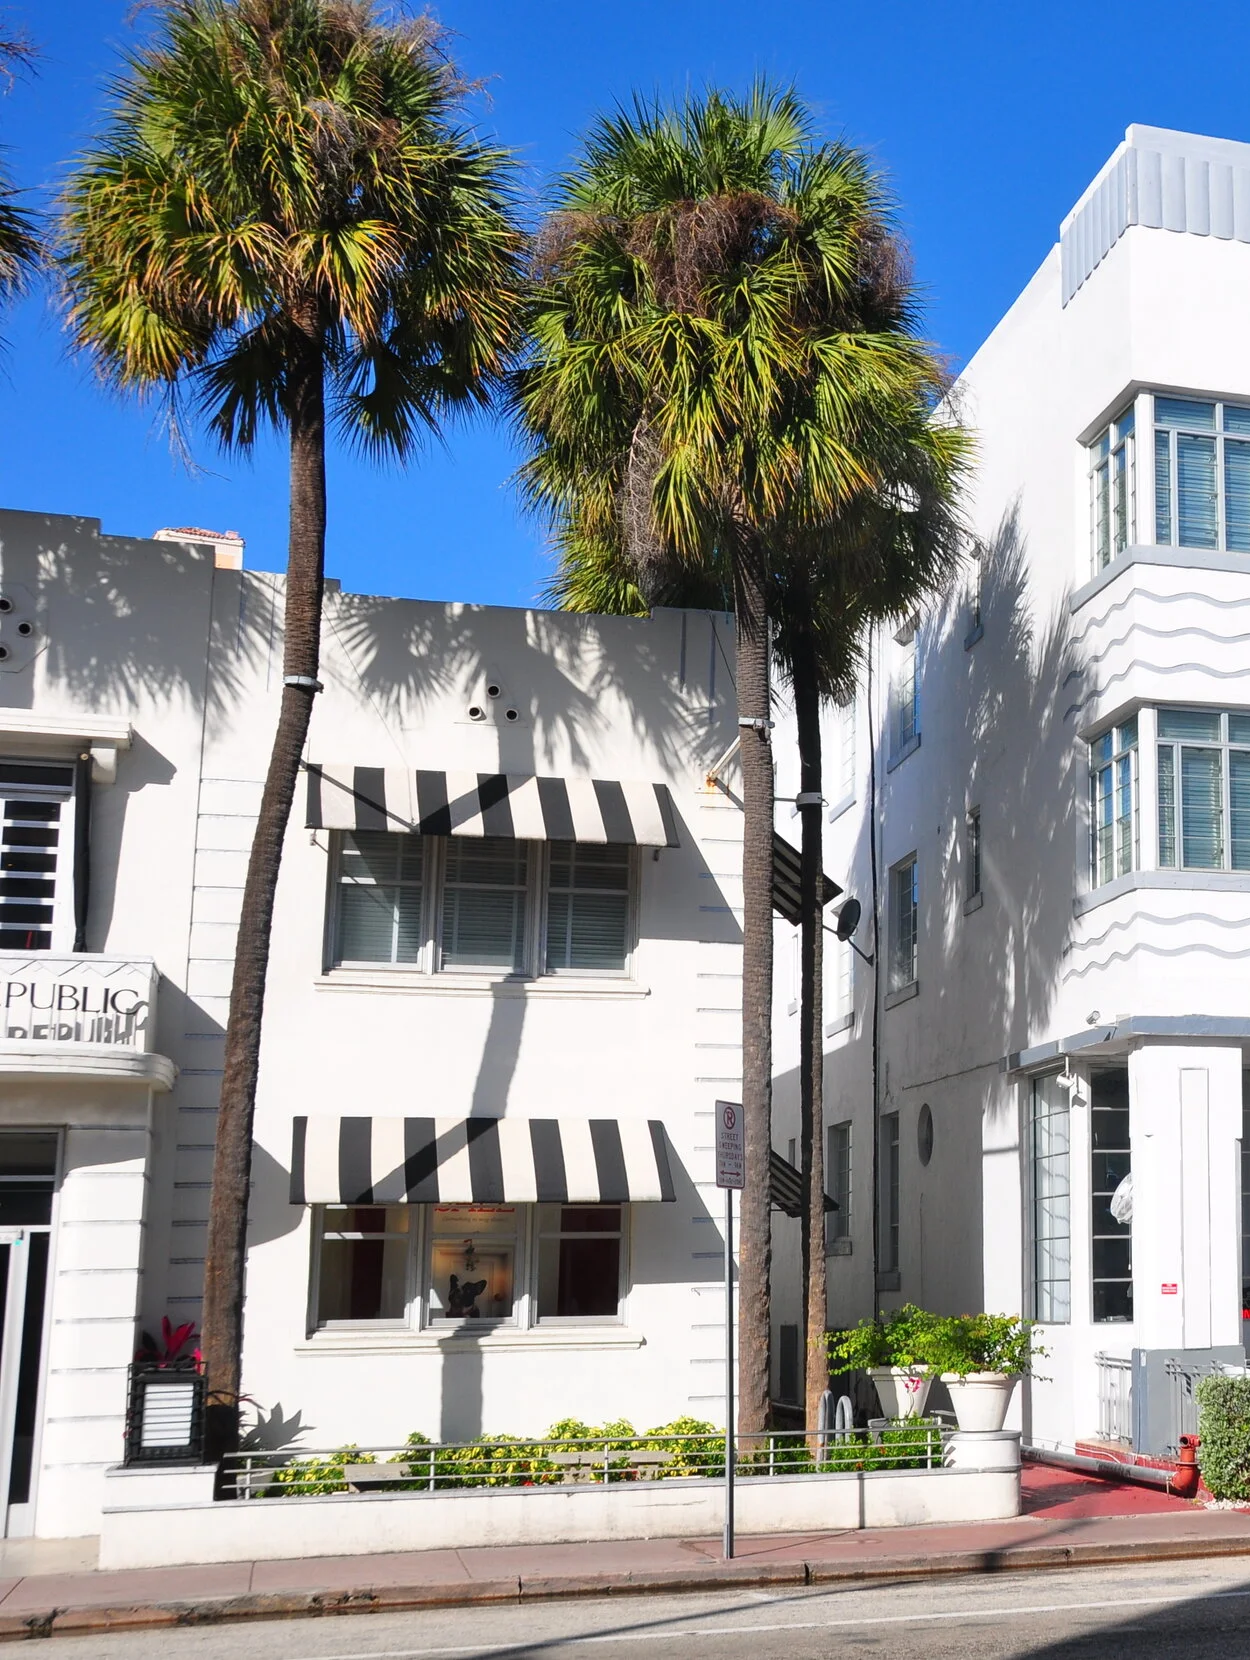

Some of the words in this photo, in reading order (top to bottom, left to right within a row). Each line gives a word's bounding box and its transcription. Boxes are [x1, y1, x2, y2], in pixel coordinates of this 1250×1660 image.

[0, 982, 139, 1015] PUBLIC
[720, 1133, 739, 1141] STREET
[719, 1142, 741, 1151] SWEEPING
